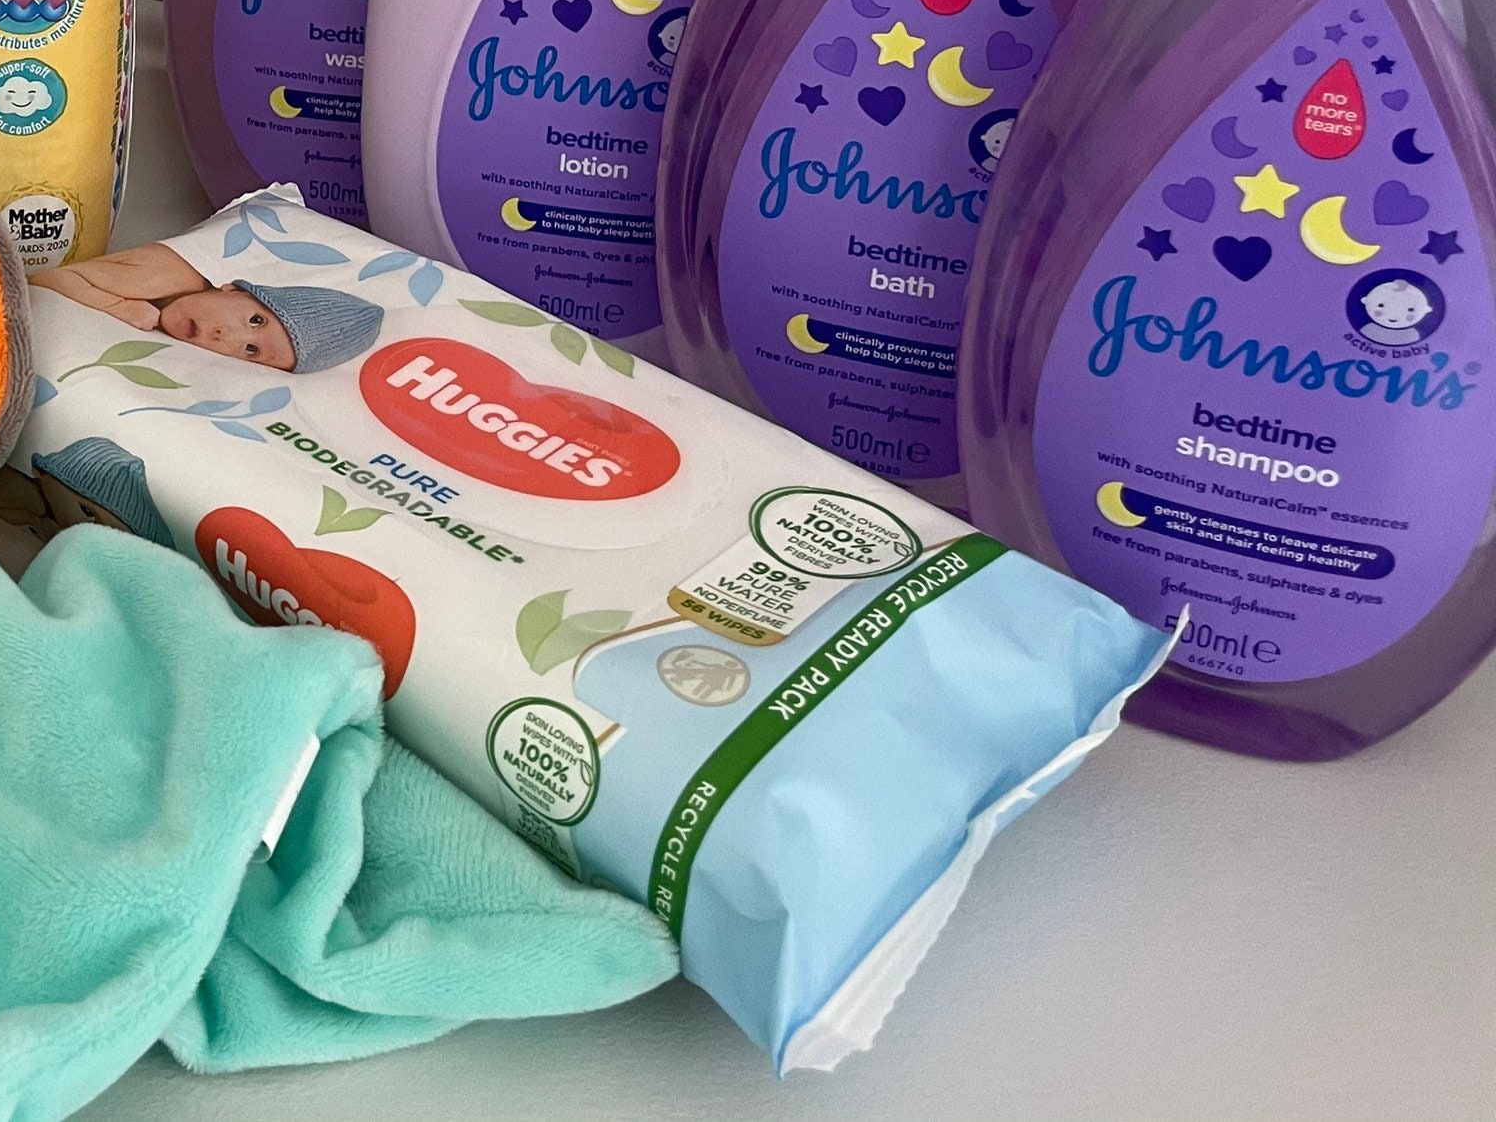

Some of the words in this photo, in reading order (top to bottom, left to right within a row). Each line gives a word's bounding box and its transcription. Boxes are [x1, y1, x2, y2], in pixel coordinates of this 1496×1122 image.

[309, 23, 365, 44] bedti
[254, 66, 277, 77] with
[278, 70, 325, 84] soothing
[325, 53, 365, 69] was
[468, 36, 671, 121] Johnso
[306, 97, 344, 108] clinically
[314, 106, 334, 116] help
[336, 108, 357, 118] baby
[1306, 104, 1358, 122] more
[1322, 92, 1348, 106] no
[9, 117, 52, 135] comfort
[246, 117, 266, 128] free
[269, 121, 293, 133] from
[545, 126, 649, 155] bedtime
[559, 153, 629, 179] lotion
[759, 127, 988, 224] Johnso
[481, 172, 506, 184] with
[509, 178, 562, 195] soothing
[9, 207, 69, 225] Mother
[21, 224, 64, 240] Baby
[542, 220, 552, 228] to
[554, 220, 576, 232] help
[577, 224, 602, 236] baby
[603, 228, 631, 238] sleep
[545, 210, 587, 224] clinically
[589, 217, 623, 227] proven
[19, 243, 45, 253] ARDS
[47, 239, 70, 252] 2020
[477, 232, 500, 244] free
[502, 237, 529, 250] from
[593, 250, 621, 262] dyes
[848, 234, 968, 275] bedtime
[870, 267, 936, 300] bath
[771, 284, 800, 300] with
[802, 293, 863, 316] soothing
[755, 346, 782, 362] free
[784, 354, 815, 371] from
[835, 331, 885, 350] clinically
[887, 341, 929, 357] proven
[845, 343, 871, 357] help
[873, 349, 901, 365] baby
[904, 356, 935, 370] sleep
[1343, 332, 1388, 358] active
[1392, 343, 1430, 359] baby
[386, 355, 624, 488] HUGGIES
[1192, 401, 1337, 455] bedtime
[1175, 434, 1341, 489] shampoo
[369, 453, 461, 505] PURE
[1097, 451, 1131, 472] with
[1134, 461, 1207, 494] soothing
[1331, 509, 1409, 531] essences
[803, 513, 877, 554] 100%
[812, 504, 854, 529] WIPES
[854, 526, 891, 546] WITH
[817, 498, 849, 516] SKIN
[851, 513, 900, 540] LOVING
[1153, 504, 1197, 524] gently
[1199, 516, 1260, 539] cleanses
[1263, 530, 1278, 542] to
[1280, 534, 1319, 551] leave
[1321, 541, 1378, 560] delicate
[776, 518, 881, 565] NATURALLY
[784, 545, 834, 570] FIBRES
[787, 535, 847, 566] DERIVED
[1165, 520, 1194, 535] skin
[1196, 528, 1223, 543] and
[1226, 534, 1254, 550] hair
[1256, 542, 1304, 563] feeling
[1307, 552, 1362, 572] healthy
[748, 561, 811, 591] 99%
[1090, 526, 1122, 545] free
[1125, 536, 1161, 557] from
[1164, 550, 1244, 581] parabens,
[1247, 572, 1326, 596] sulphates
[1328, 587, 1341, 599] &
[1344, 591, 1384, 605] dyes
[718, 577, 794, 614] WATER
[736, 573, 798, 601] PURE
[887, 551, 969, 614] RECYCLE
[681, 599, 706, 613] 56
[708, 610, 766, 640] WIPES
[693, 586, 719, 601] NO
[717, 599, 787, 630] PERFUME
[825, 607, 893, 672] READY
[1188, 654, 1244, 676] 666740
[768, 666, 830, 721] PACK
[523, 723, 552, 748] WIPES
[553, 743, 578, 766] WITH
[525, 711, 549, 731] SKIN
[549, 725, 585, 754] LOVING
[503, 750, 575, 803] NATURALLY
[519, 738, 569, 783] 100%
[658, 780, 718, 881] RECYCLE
[655, 884, 674, 922] REA
